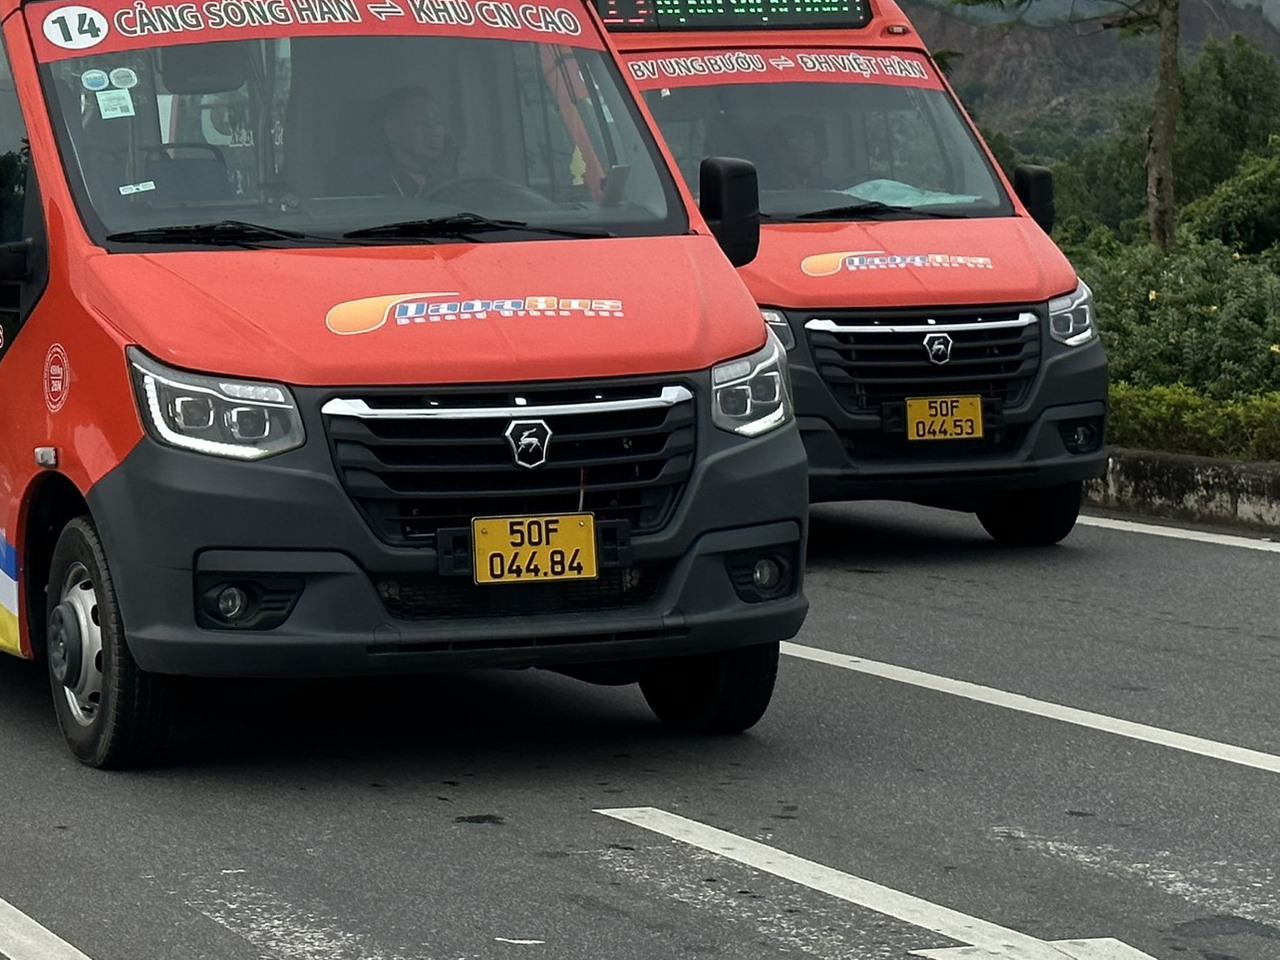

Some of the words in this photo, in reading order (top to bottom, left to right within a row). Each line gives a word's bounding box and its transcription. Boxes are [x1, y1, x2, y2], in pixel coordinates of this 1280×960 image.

[51, 12, 101, 43] 14
[114, 1, 202, 37] CẢNG
[476, 0, 521, 29] CN
[519, 4, 582, 36] CAO
[628, 60, 658, 80] BV
[658, 56, 709, 77] UNG
[797, 53, 835, 73] ĐH
[829, 52, 879, 78] VIỆT
[877, 55, 928, 79] HÀN
[928, 400, 960, 418] 50F
[915, 418, 975, 438] 044.53
[508, 519, 560, 548] 50F
[488, 548, 584, 579] 044.84
